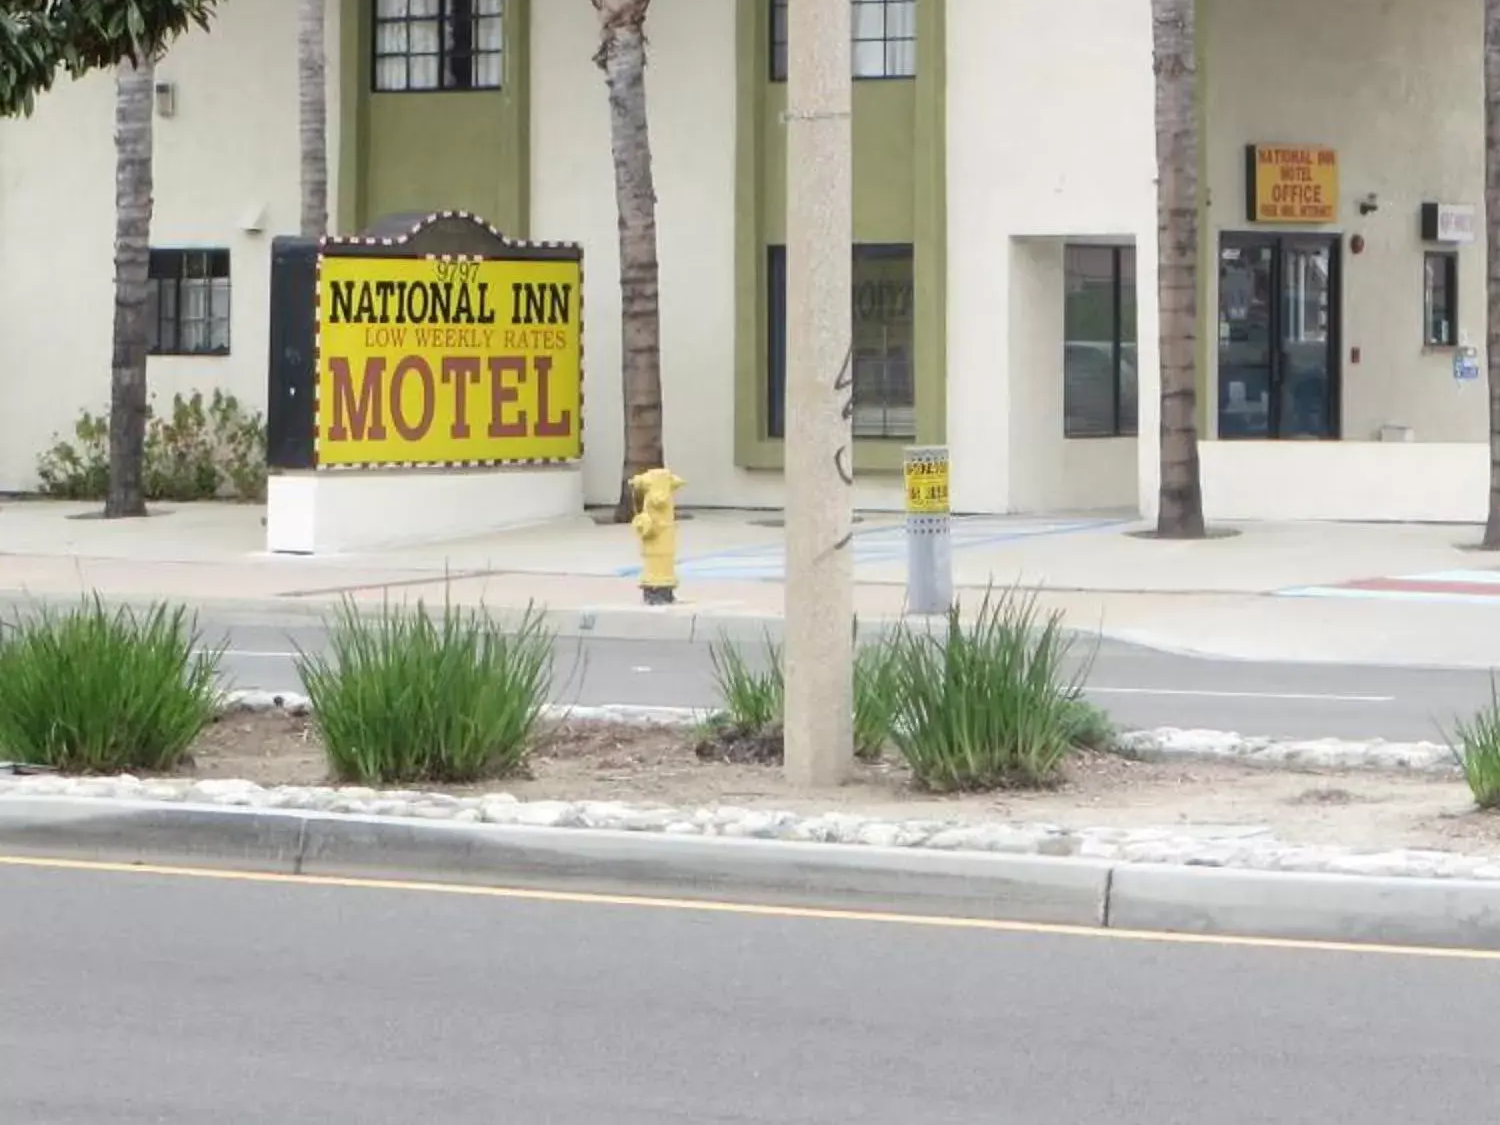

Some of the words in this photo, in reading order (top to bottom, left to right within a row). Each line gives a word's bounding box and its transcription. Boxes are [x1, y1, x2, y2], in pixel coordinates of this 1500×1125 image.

[1258, 149, 1314, 164] NATIONAL
[1271, 183, 1321, 203] OFFICE
[436, 262, 480, 283] 9797
[329, 280, 495, 324] NATIONAL
[511, 283, 571, 324] INN
[365, 328, 405, 348] LOW
[415, 329, 495, 349] WEEKLY
[504, 330, 567, 350] RATES
[328, 355, 571, 442] MOTEL
